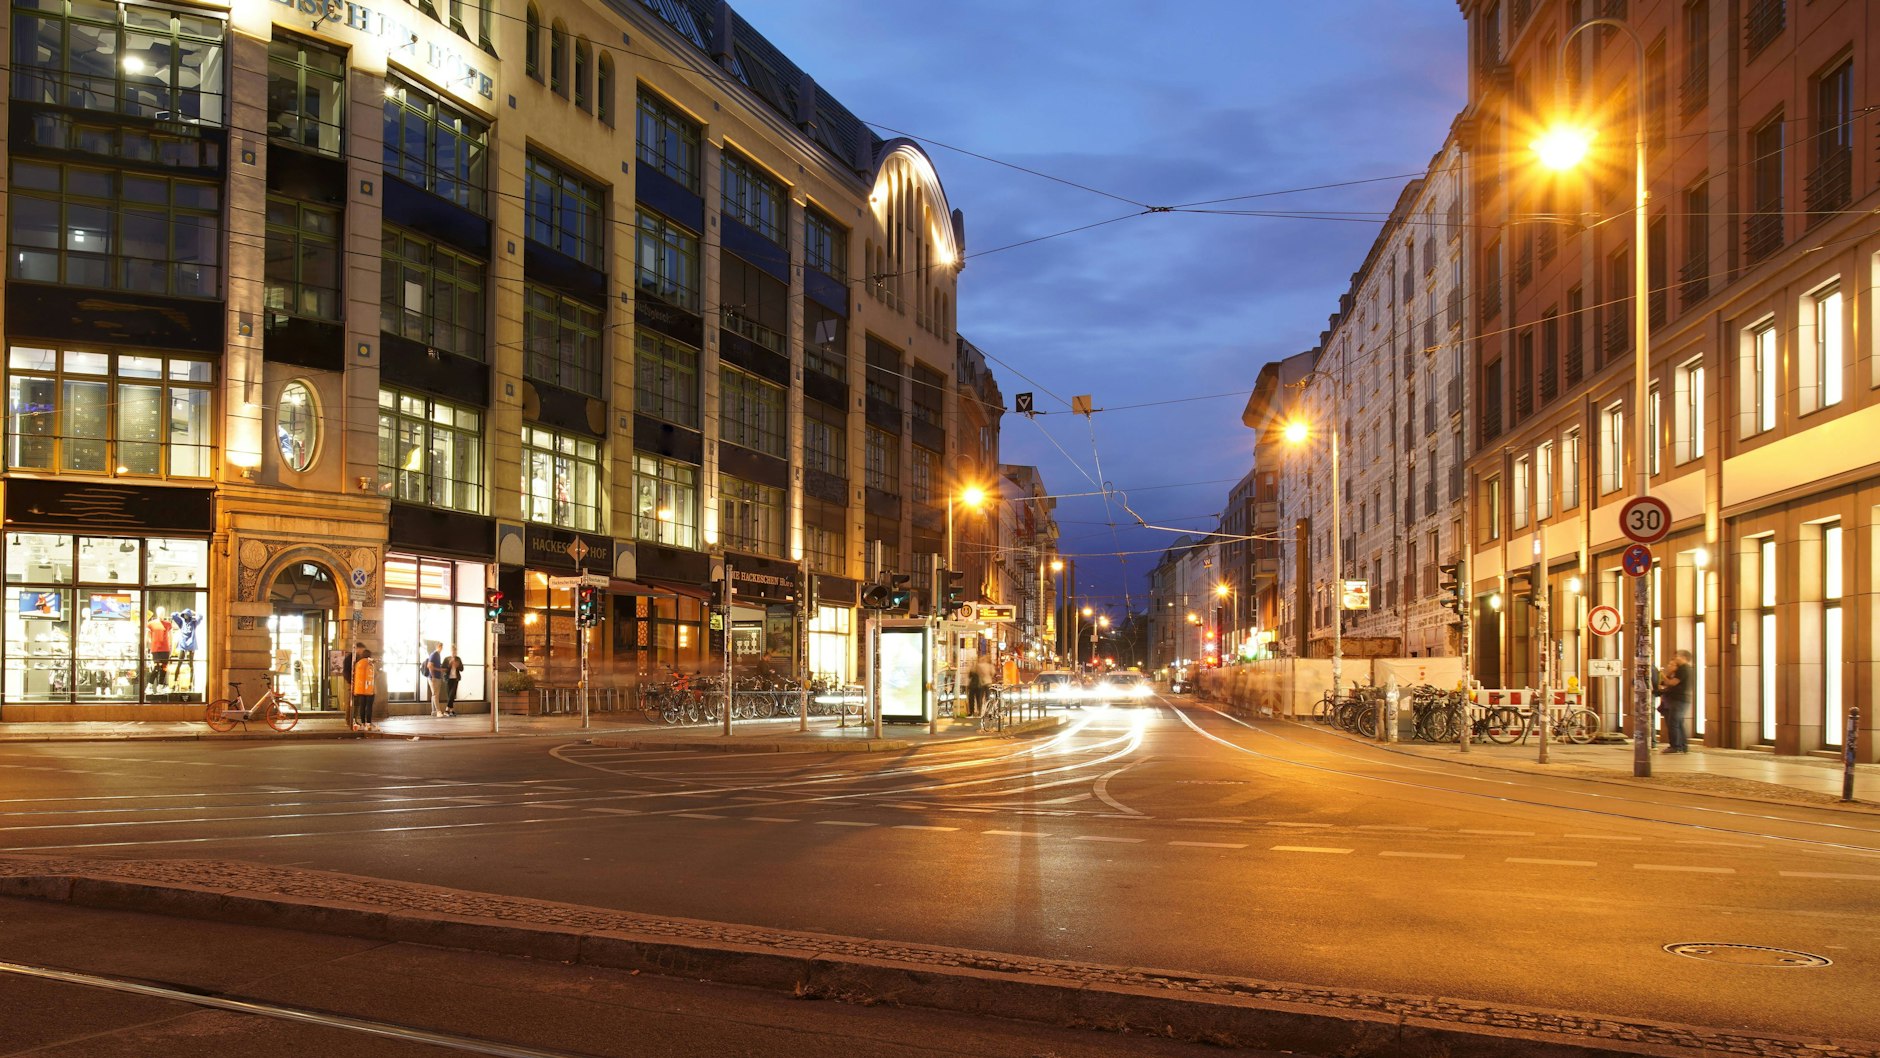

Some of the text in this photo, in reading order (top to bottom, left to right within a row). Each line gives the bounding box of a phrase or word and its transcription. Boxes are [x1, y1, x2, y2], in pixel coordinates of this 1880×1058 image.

[273, 0, 419, 57] SCHEN
[1631, 509, 1661, 531] 30
[532, 537, 607, 559] HACKES HOF
[741, 571, 779, 586] HACKESCHEN
